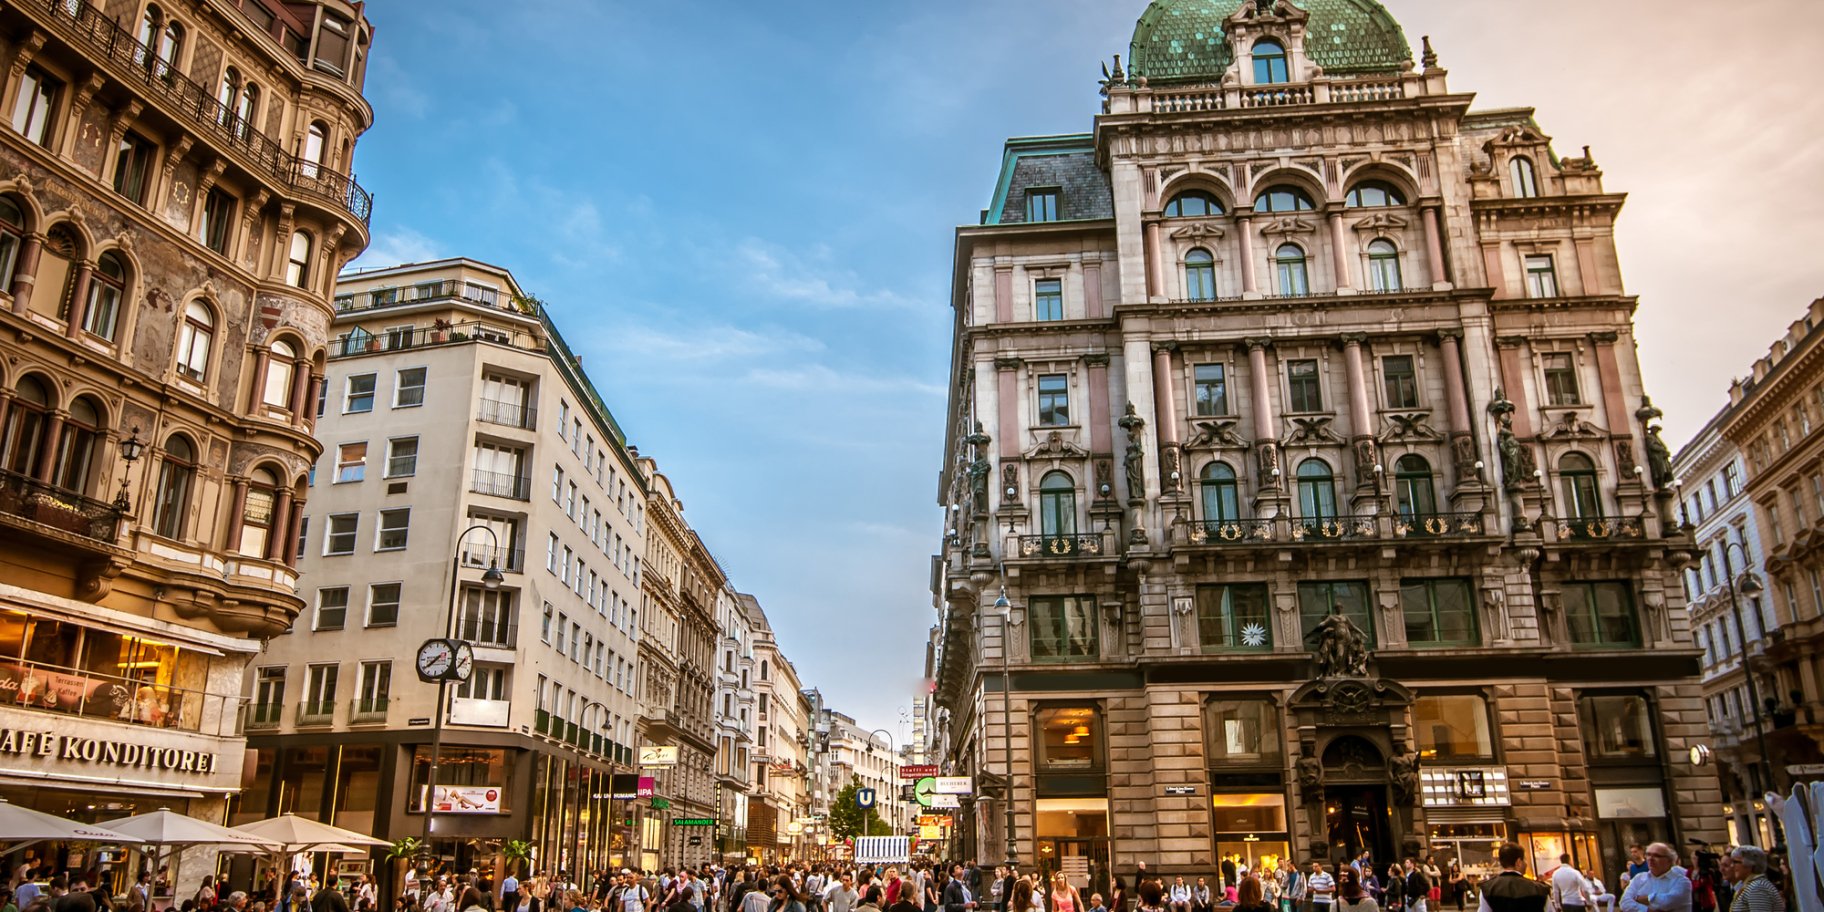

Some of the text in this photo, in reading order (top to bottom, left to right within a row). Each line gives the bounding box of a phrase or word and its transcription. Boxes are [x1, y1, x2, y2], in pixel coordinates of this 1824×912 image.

[55, 675, 84, 687] Terrassen
[58, 687, 77, 697] Kaffee
[0, 730, 217, 773] AFÉ KONDITOREI
[860, 792, 872, 805] U
